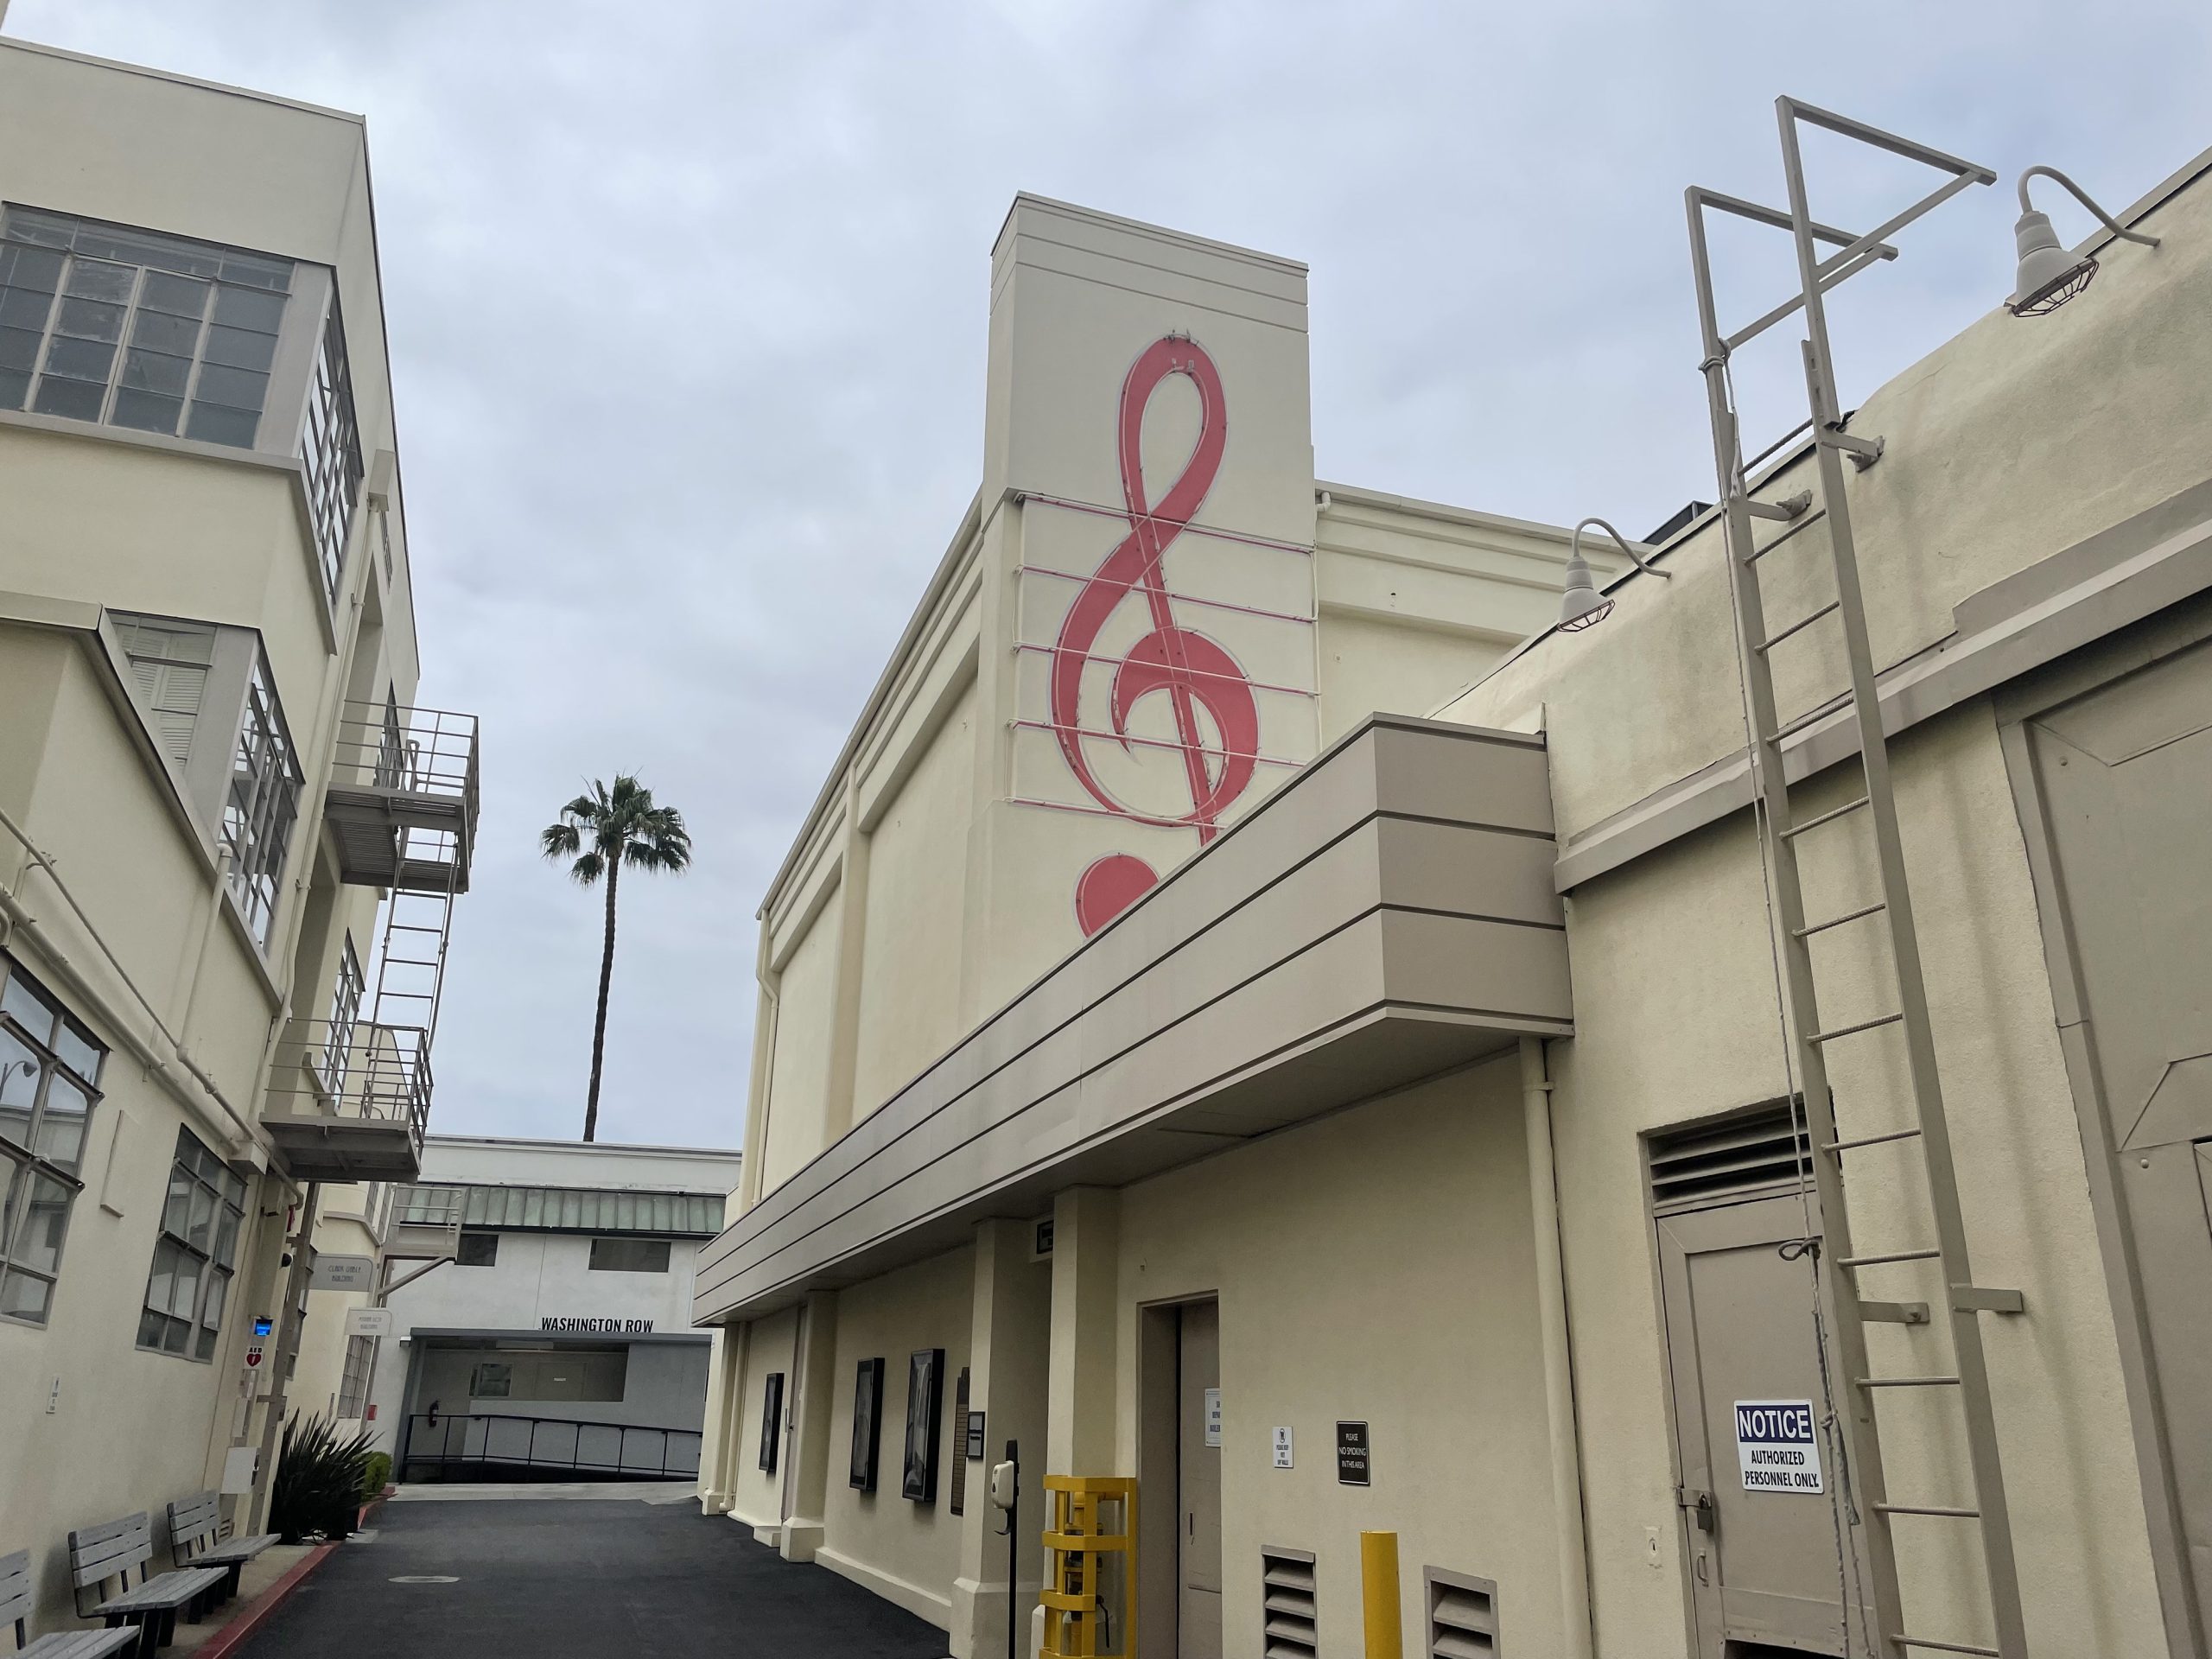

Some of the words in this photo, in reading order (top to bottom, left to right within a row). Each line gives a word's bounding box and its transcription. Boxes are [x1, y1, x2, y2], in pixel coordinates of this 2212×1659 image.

[542, 1318, 621, 1332] WASHINGTON
[626, 1319, 654, 1333] ROW
[1738, 1409, 1812, 1439] NOTICE
[1345, 1433, 1359, 1441] PLEASE
[1338, 1446, 1347, 1455] NO
[1346, 1446, 1367, 1457] SMOKING
[1751, 1450, 1805, 1465] AUTHORIZED
[1354, 1460, 1365, 1470] AREA
[1745, 1471, 1794, 1487] PERSONNEL
